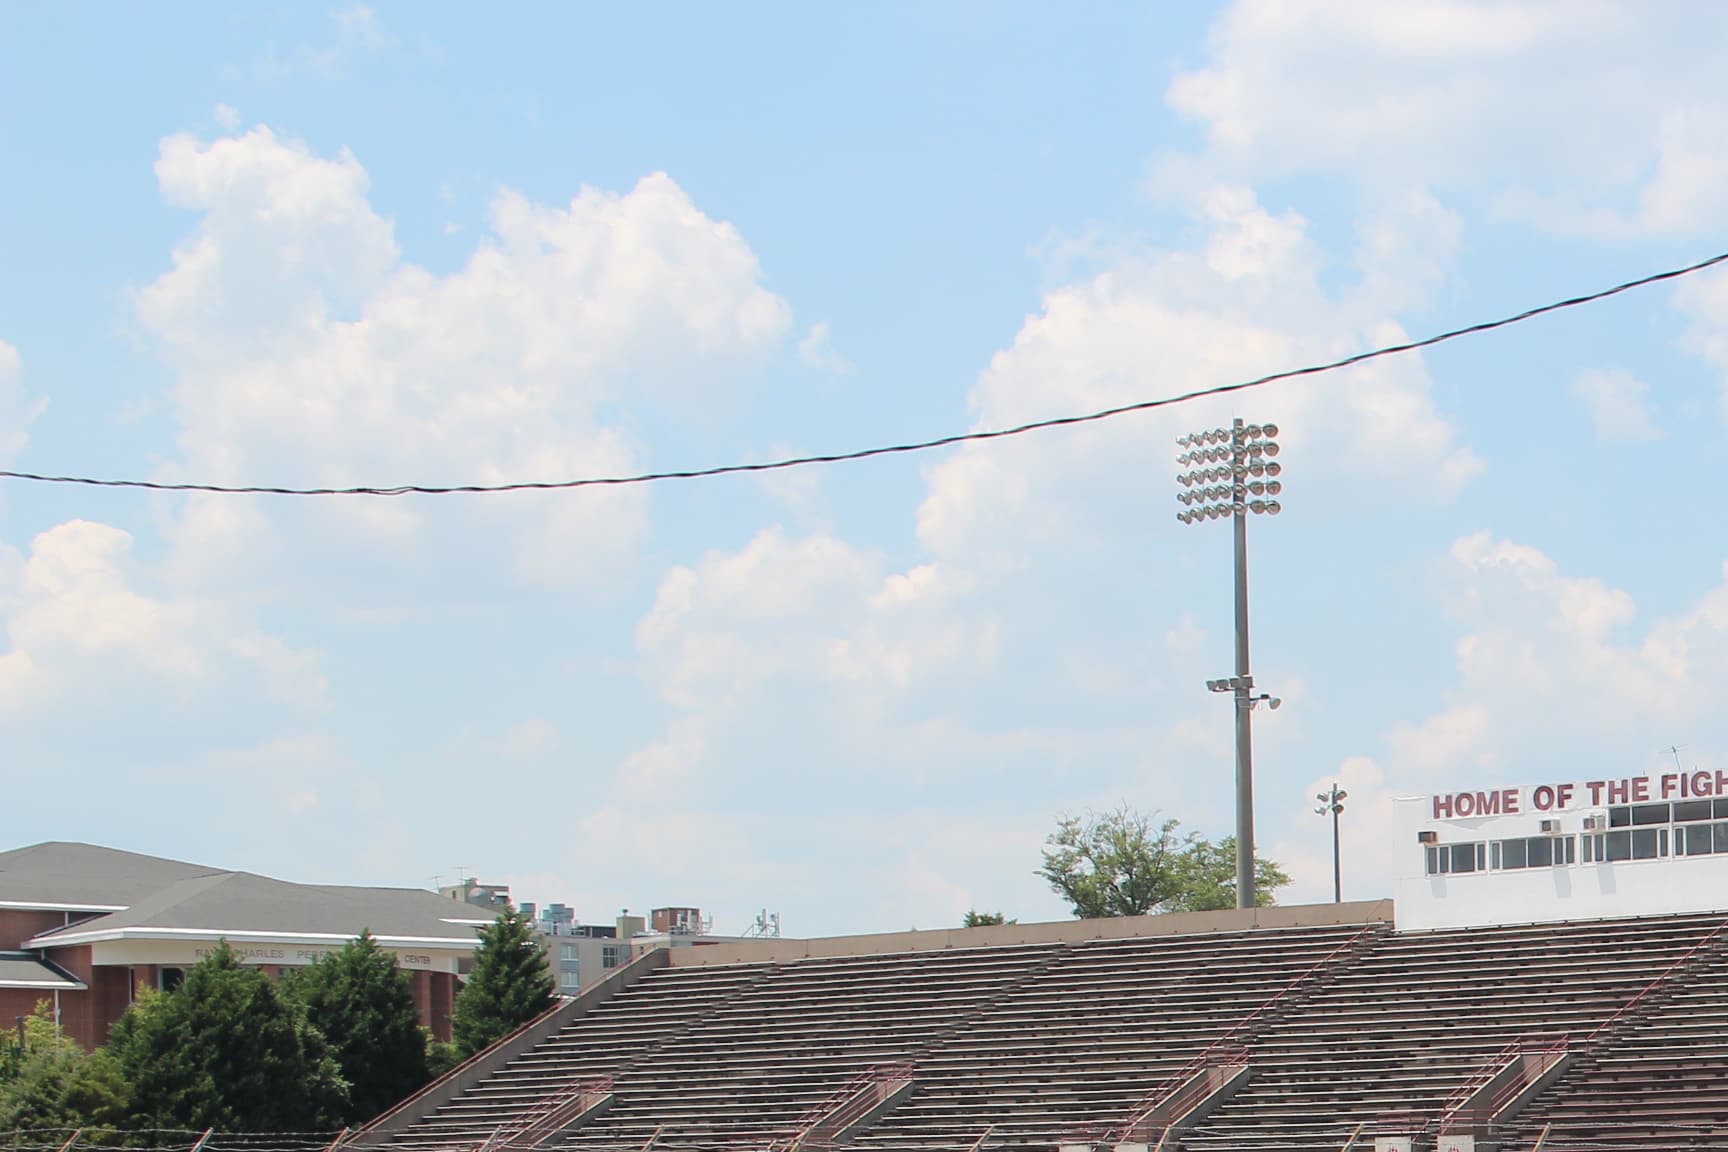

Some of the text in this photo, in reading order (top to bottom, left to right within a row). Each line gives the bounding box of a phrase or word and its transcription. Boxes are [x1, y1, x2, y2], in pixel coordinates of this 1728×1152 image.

[1434, 789, 1519, 819] HOME
[1534, 784, 1573, 811] OF
[1587, 777, 1649, 806] THE
[232, 949, 285, 959] HARLES
